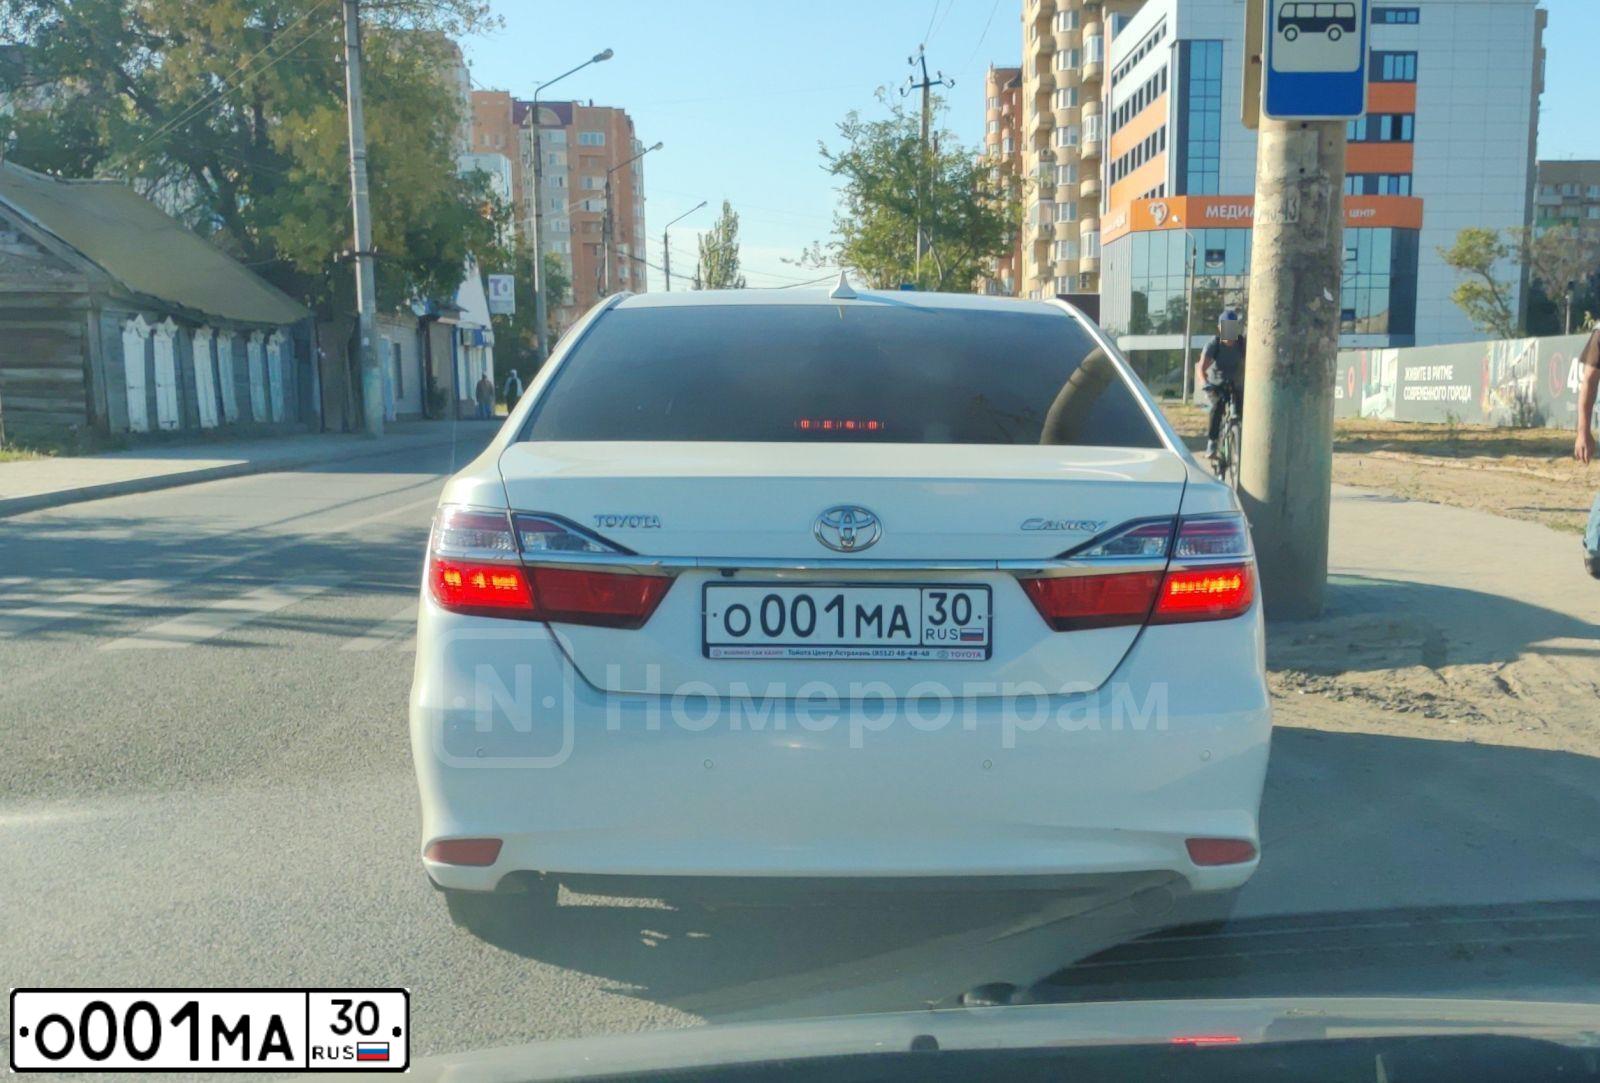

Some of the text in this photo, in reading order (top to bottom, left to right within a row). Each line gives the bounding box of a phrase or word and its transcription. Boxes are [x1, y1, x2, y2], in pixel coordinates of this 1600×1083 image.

[1404, 366, 1426, 381] ЖИВИТЕ
[1432, 365, 1454, 381] РИТМЕ
[1403, 384, 1472, 404] СОВРЕМЕННОГО ГОРОДА
[594, 514, 662, 528] TOYOTA
[928, 593, 972, 626] 30
[926, 628, 959, 640] RUS
